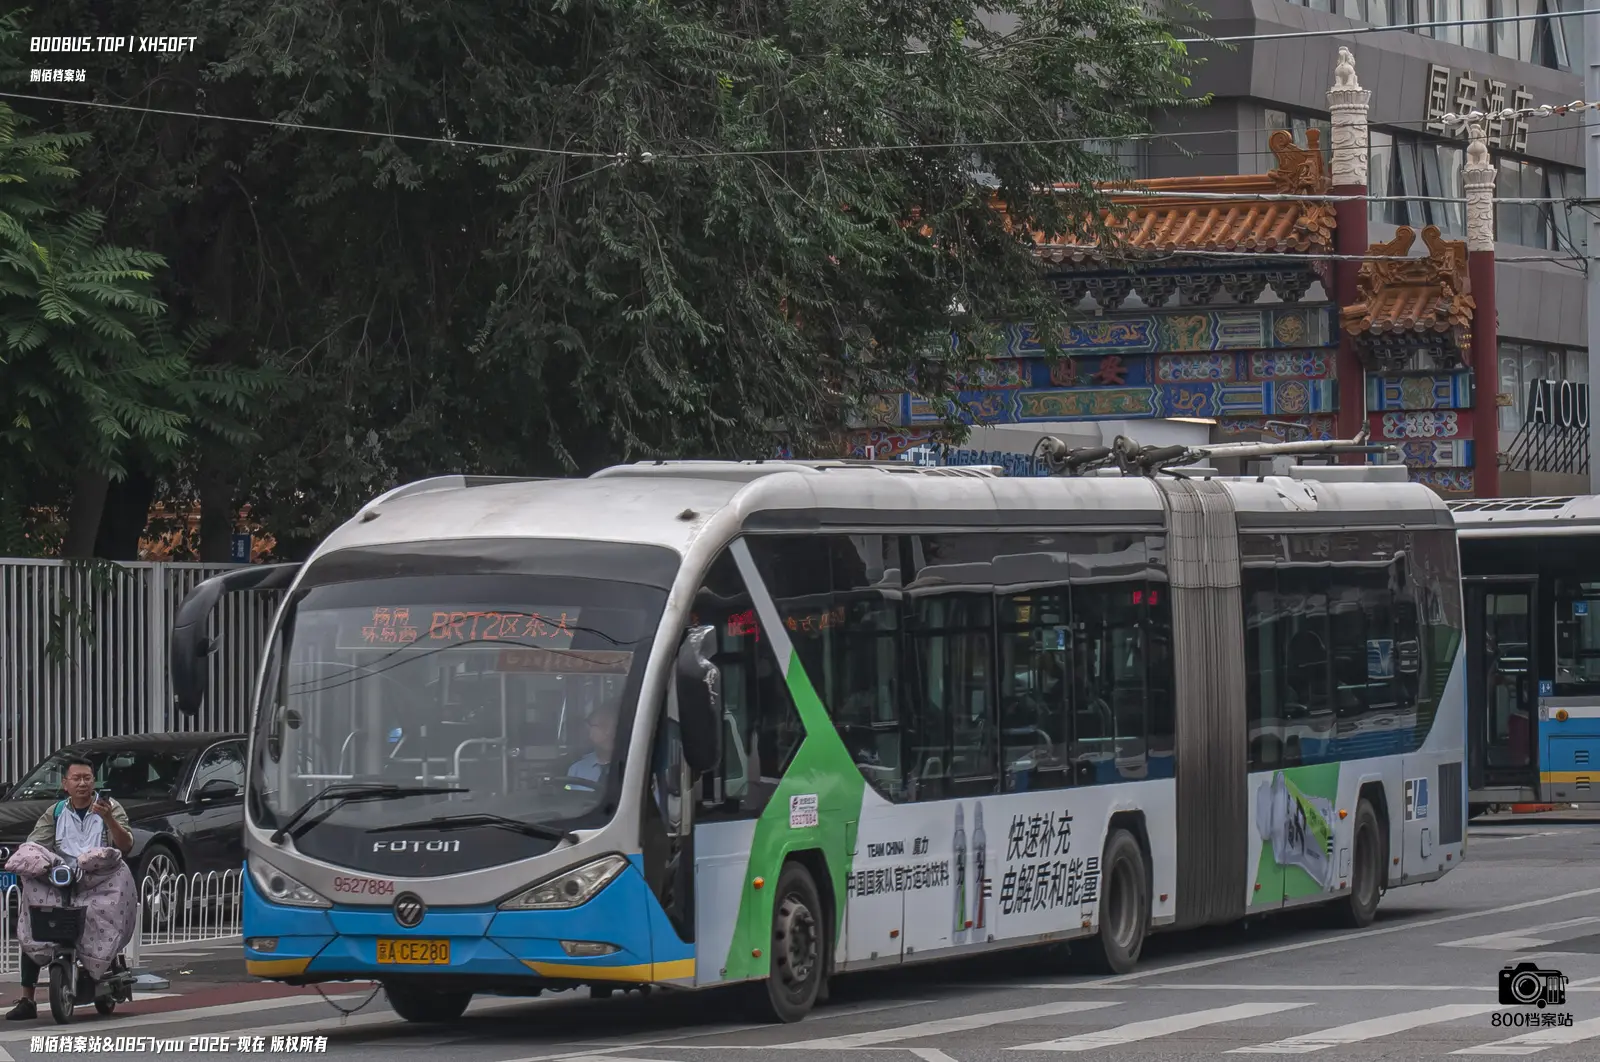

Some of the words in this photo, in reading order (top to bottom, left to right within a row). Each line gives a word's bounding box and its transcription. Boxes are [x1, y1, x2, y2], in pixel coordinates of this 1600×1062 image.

[1426, 63, 1534, 154] 国安酒店
[373, 840, 460, 853] FOTON
[867, 843, 885, 858] TEAM
[885, 840, 905, 857] CHINA
[1006, 809, 1073, 862] 快速补充
[334, 876, 395, 896] 9527884
[846, 859, 950, 898] 中国国家队官方运动饮料
[999, 856, 1100, 915] 电解质和能量
